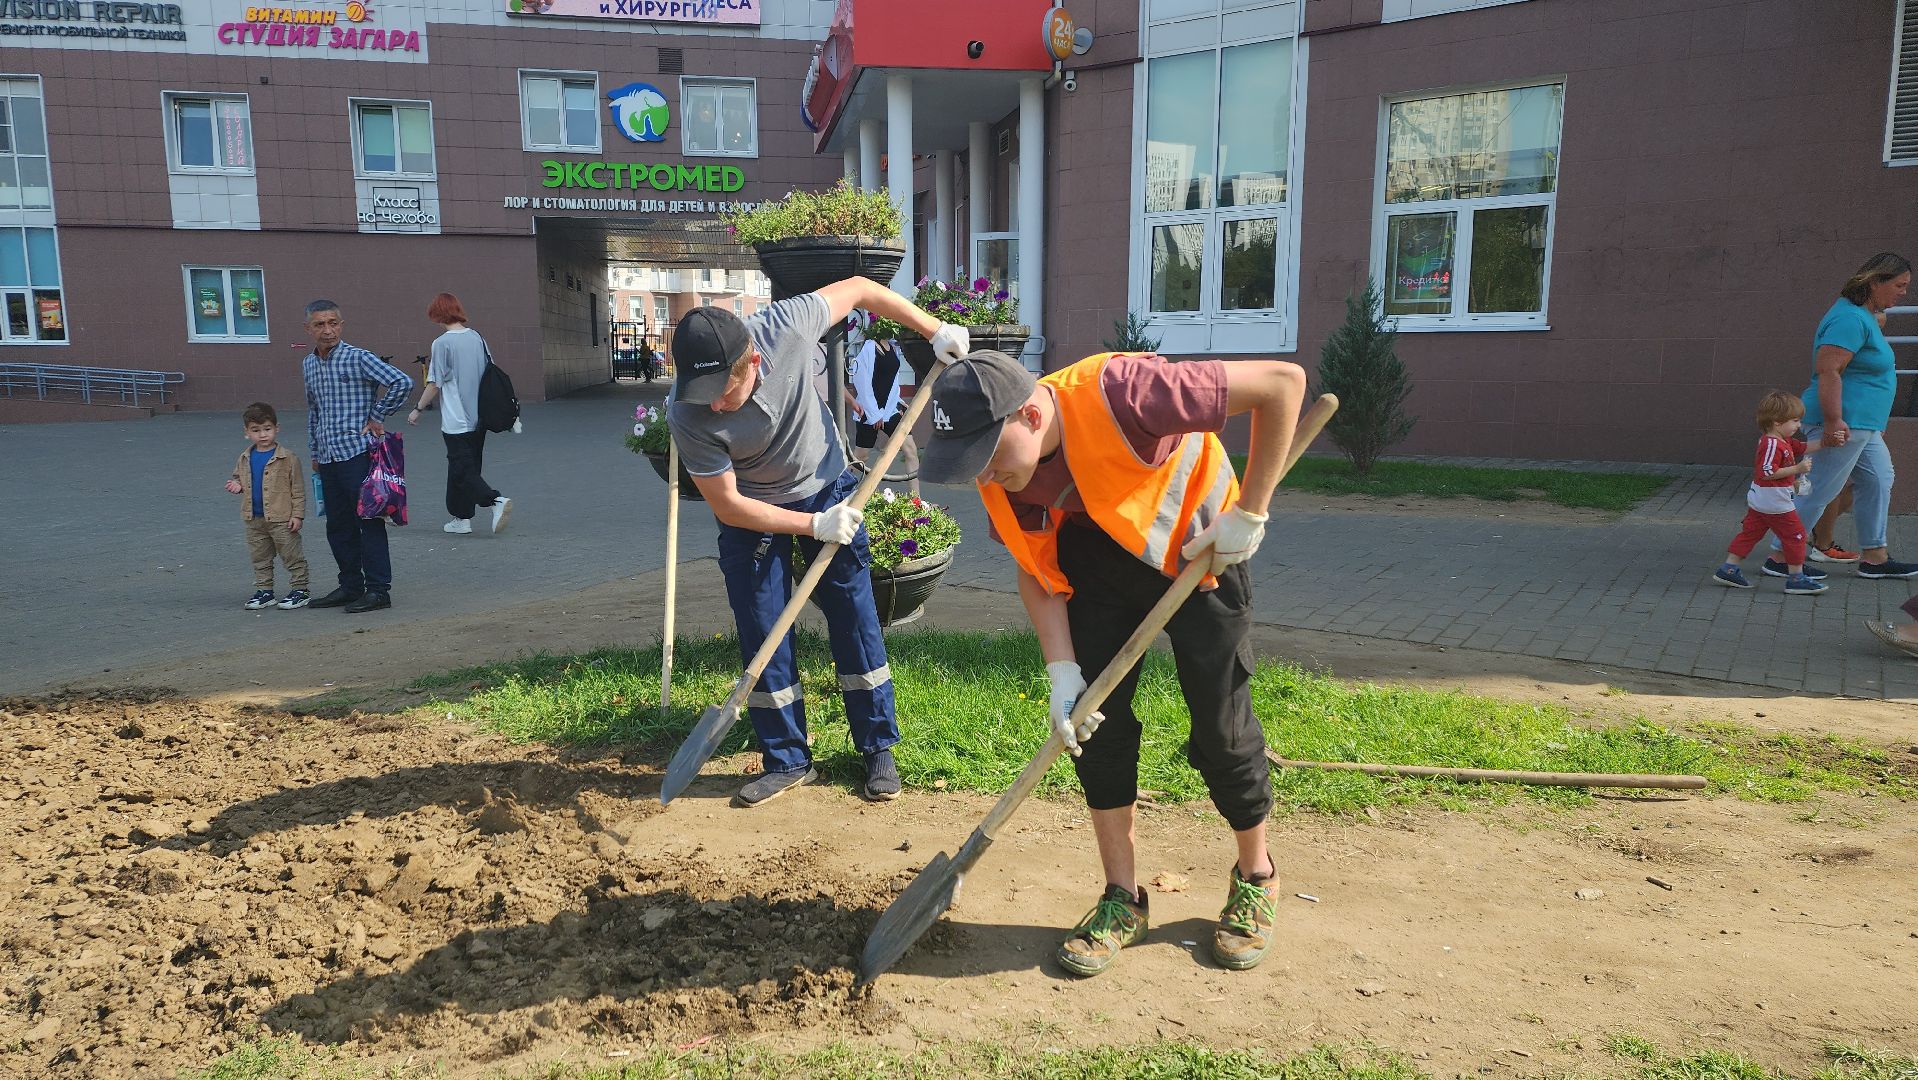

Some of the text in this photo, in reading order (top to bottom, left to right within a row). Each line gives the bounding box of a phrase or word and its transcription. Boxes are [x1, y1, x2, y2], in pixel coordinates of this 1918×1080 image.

[92, 1, 183, 24] REPAIR
[246, 7, 336, 25] ВИТАМИН
[615, 0, 718, 19] ХИРУРГИЯ
[0, 24, 187, 41] ЕМОНТ МОБИЛЬНОЙ ТЕХНИКИ
[1054, 17, 1073, 39] 24
[218, 23, 420, 52] СТУДИЯ ЗАГАРА
[373, 194, 418, 208] Класс
[504, 196, 528, 209] ЛОР
[533, 198, 541, 209] И
[543, 198, 637, 212] СТОМАТОЛОГИЯ
[640, 199, 666, 213] ДЛЯ
[669, 198, 705, 214] ДЕТЕЙ
[708, 201, 716, 213] И
[357, 210, 436, 223] на Чехова
[933, 400, 953, 430] LA
